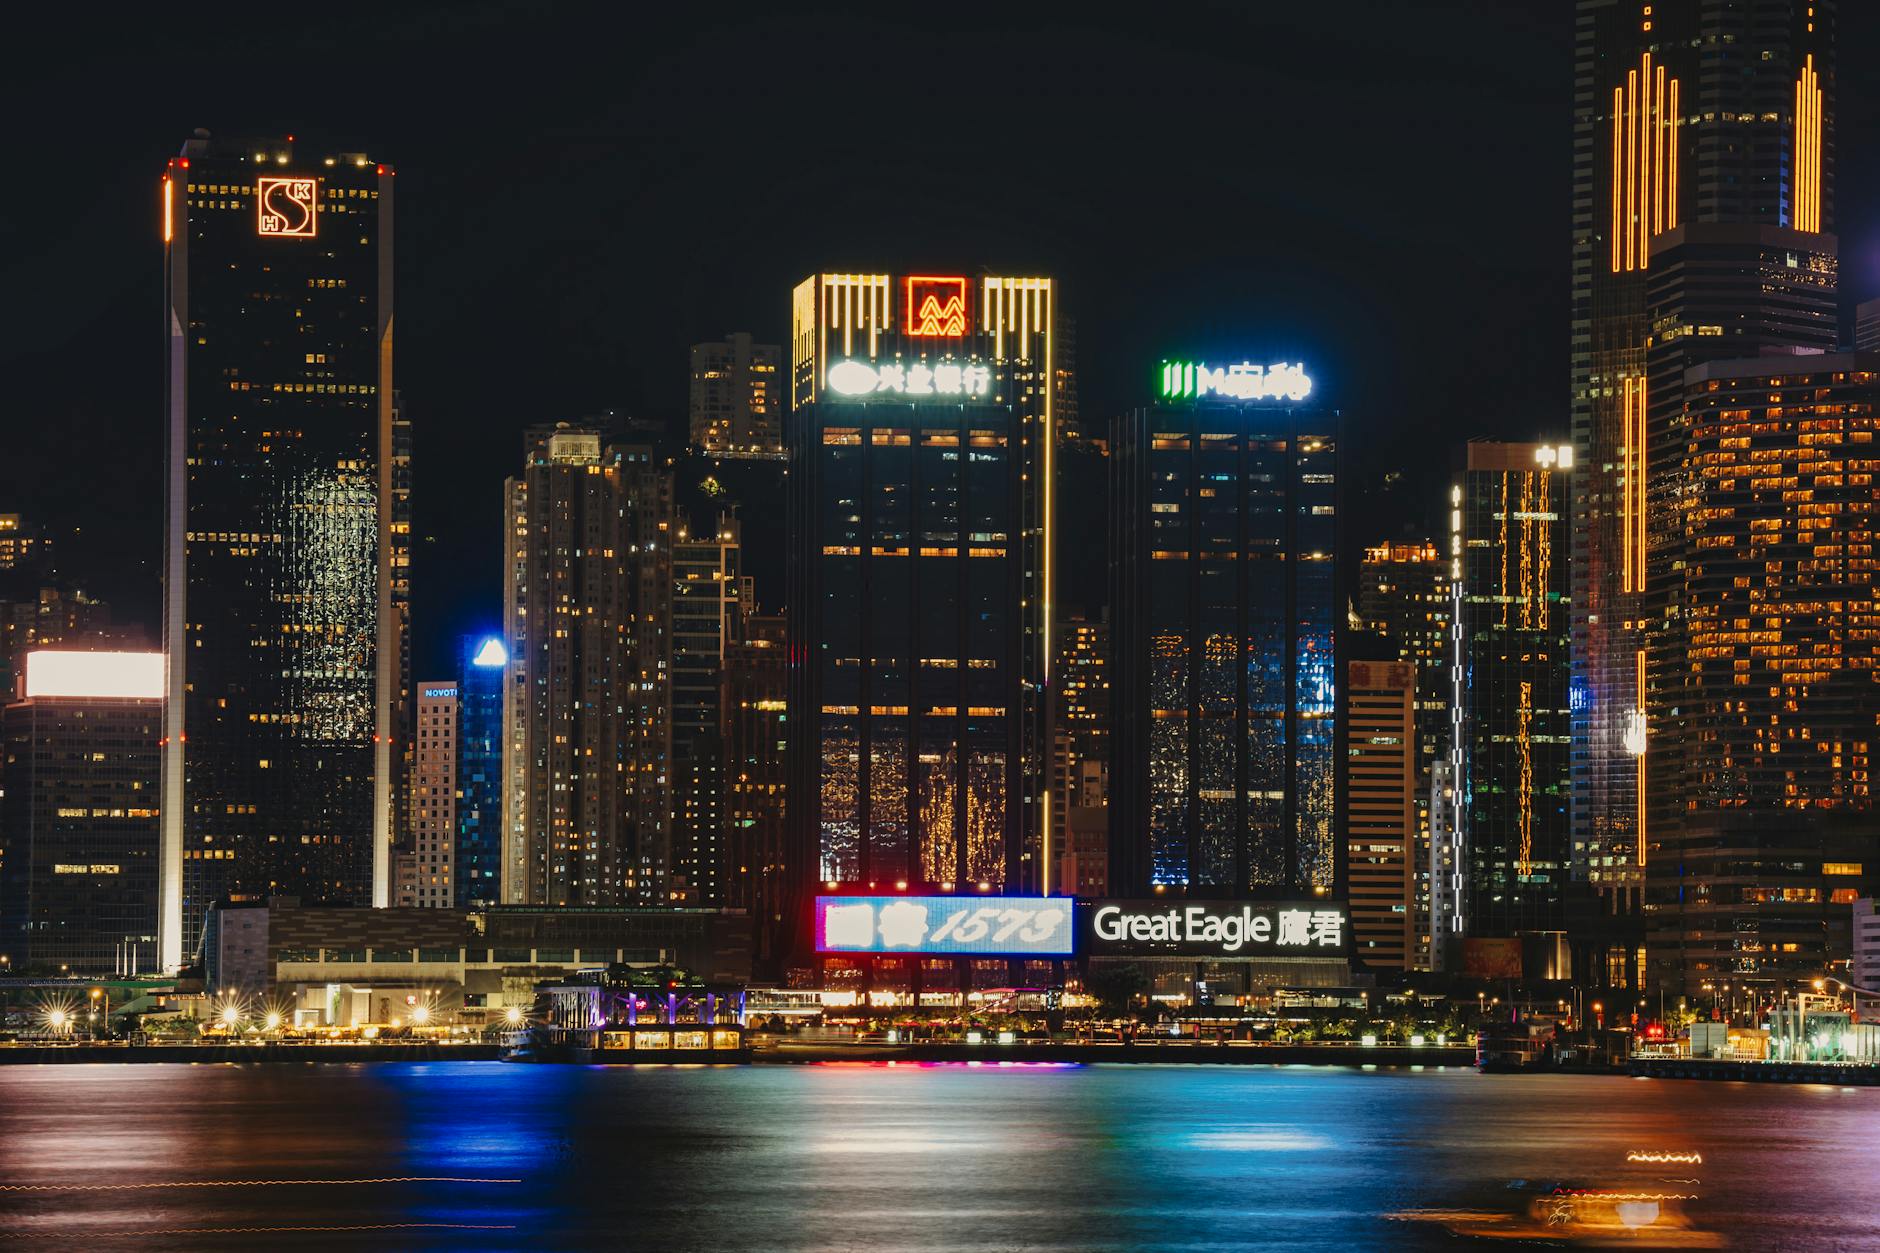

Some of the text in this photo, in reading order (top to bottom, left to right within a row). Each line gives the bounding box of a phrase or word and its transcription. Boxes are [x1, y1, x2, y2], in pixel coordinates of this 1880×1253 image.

[930, 908, 1064, 942] 1573
[1094, 906, 1271, 951] Great Eagle
